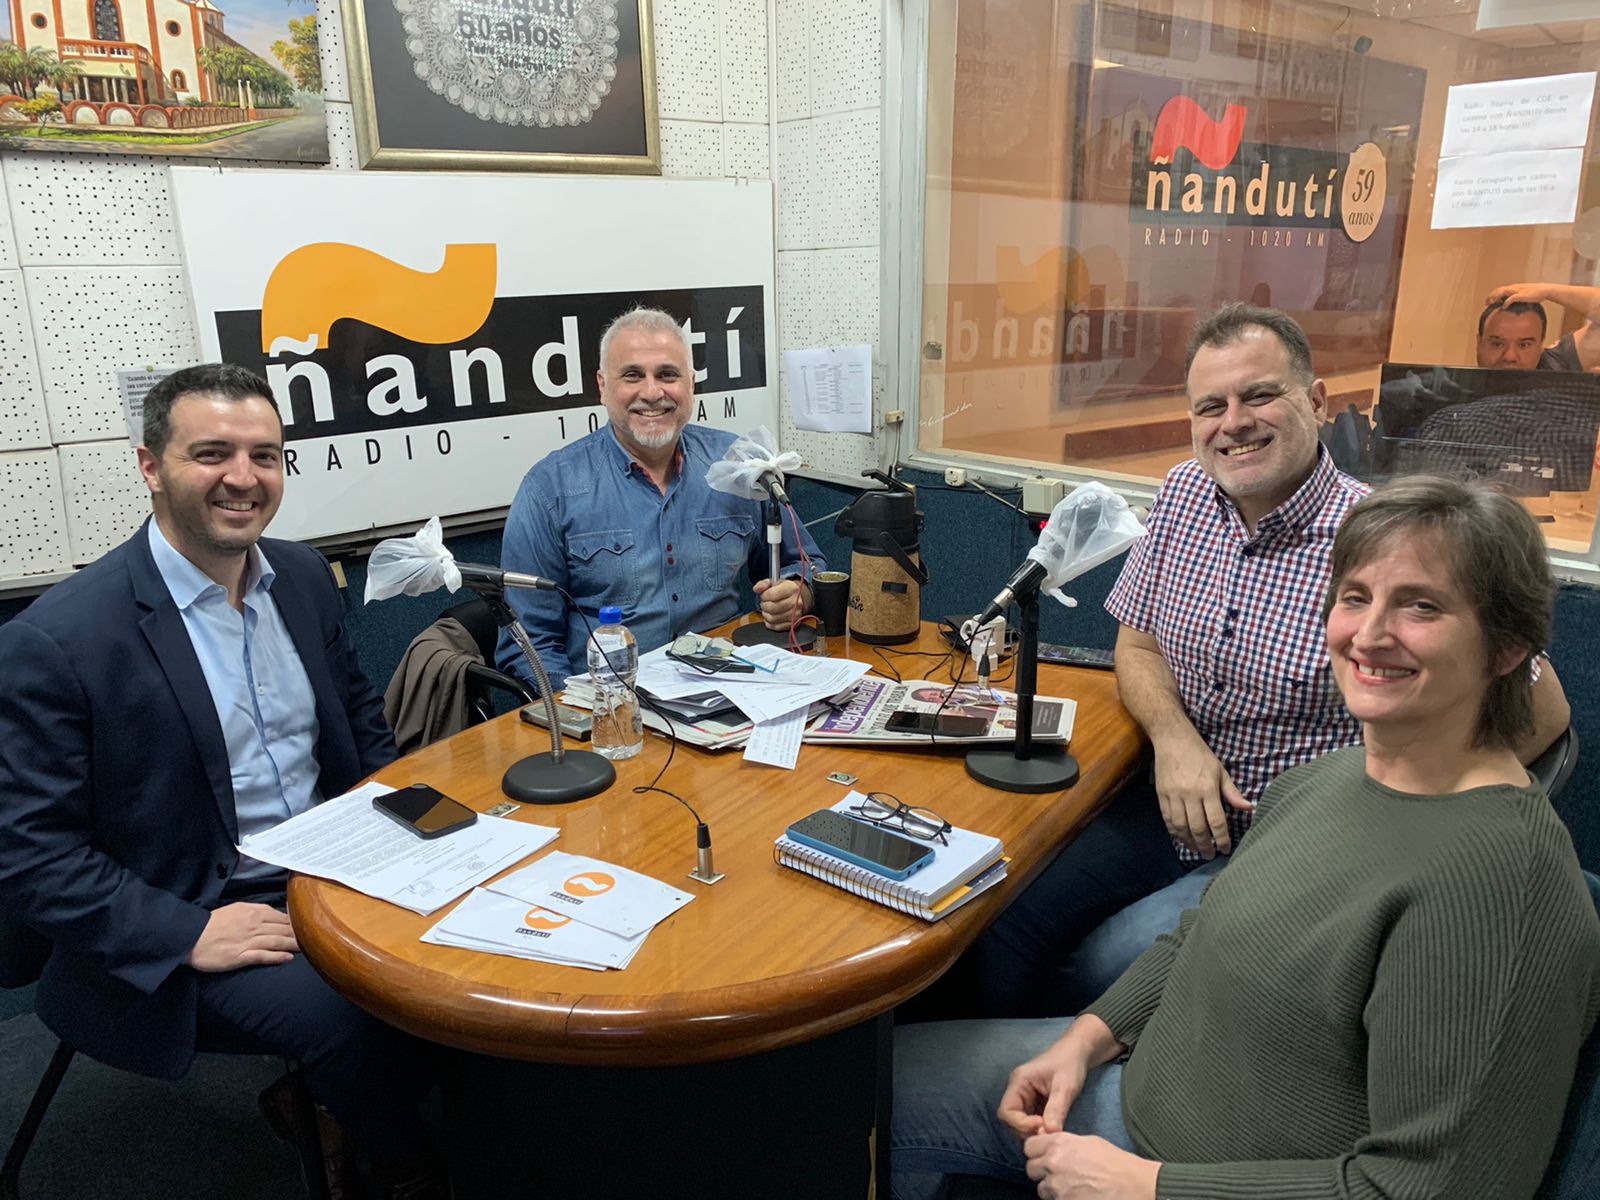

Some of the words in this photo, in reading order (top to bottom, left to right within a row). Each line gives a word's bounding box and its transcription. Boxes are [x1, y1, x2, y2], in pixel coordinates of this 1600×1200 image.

[1146, 155, 1337, 219] ñandutí
[1352, 169, 1375, 203] 59
[1144, 228, 1210, 247] RADIO
[1250, 230, 1292, 248] 1020
[1305, 232, 1325, 248] AM
[266, 307, 744, 426] ñandtí
[284, 430, 451, 477] RADIO
[558, 412, 598, 440] 10
[697, 397, 736, 422] AM
